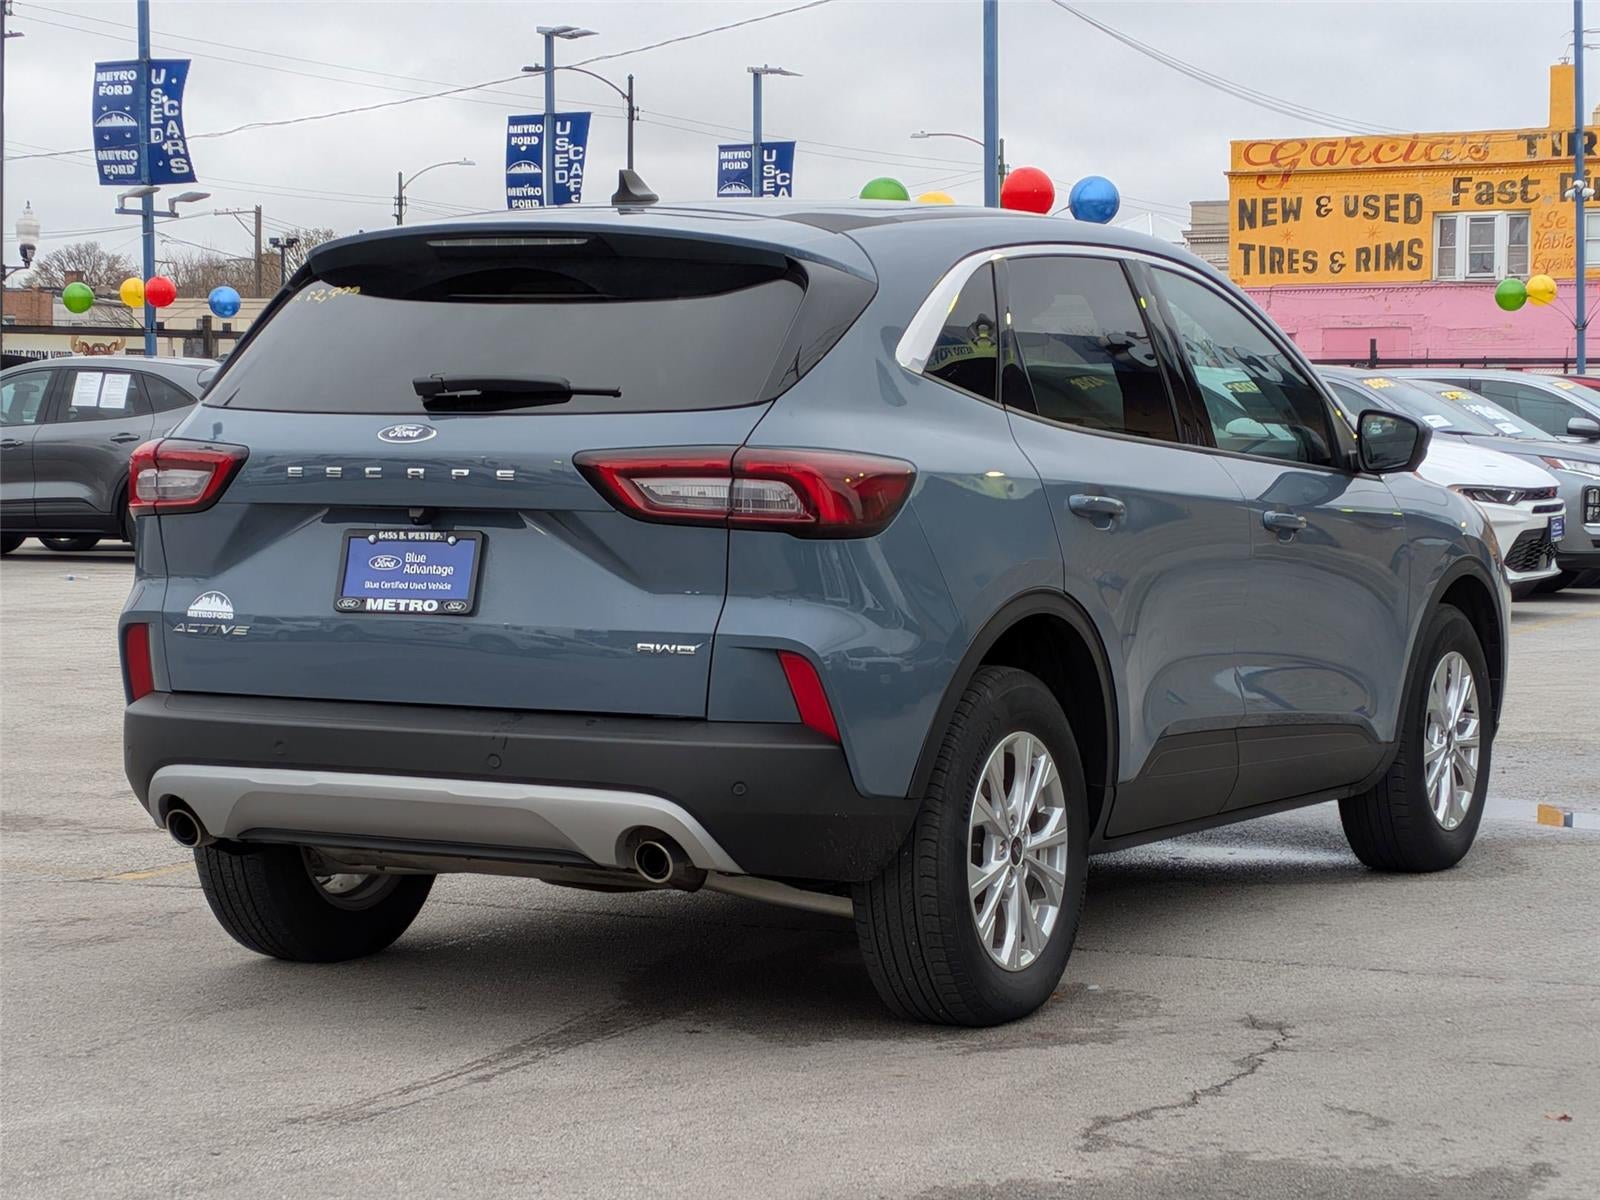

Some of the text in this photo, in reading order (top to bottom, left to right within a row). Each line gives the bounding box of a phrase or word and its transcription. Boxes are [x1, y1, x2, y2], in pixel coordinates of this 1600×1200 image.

[96, 70, 138, 82] METRO
[98, 84, 133, 96] FORD
[150, 68, 166, 144] USED
[508, 124, 543, 134] METRO
[163, 99, 190, 174] CARS
[511, 136, 540, 146] FORD
[97, 149, 139, 161] METRO
[555, 121, 571, 184] USED
[720, 151, 752, 160] METRO
[103, 164, 136, 176] FORD
[722, 161, 749, 171] FORD
[507, 187, 542, 197] METRO
[1451, 174, 1541, 206] Fast
[1238, 192, 1424, 231] NEW & USED
[1238, 238, 1424, 276] TIRES & RIMS
[287, 466, 516, 481] ESCAPE
[405, 552, 427, 563] Blue
[403, 564, 454, 576] Advantage
[365, 580, 452, 590] Blue Certified Used Vehicle
[365, 598, 439, 612] METRO
[173, 623, 251, 635] ACTIVE
